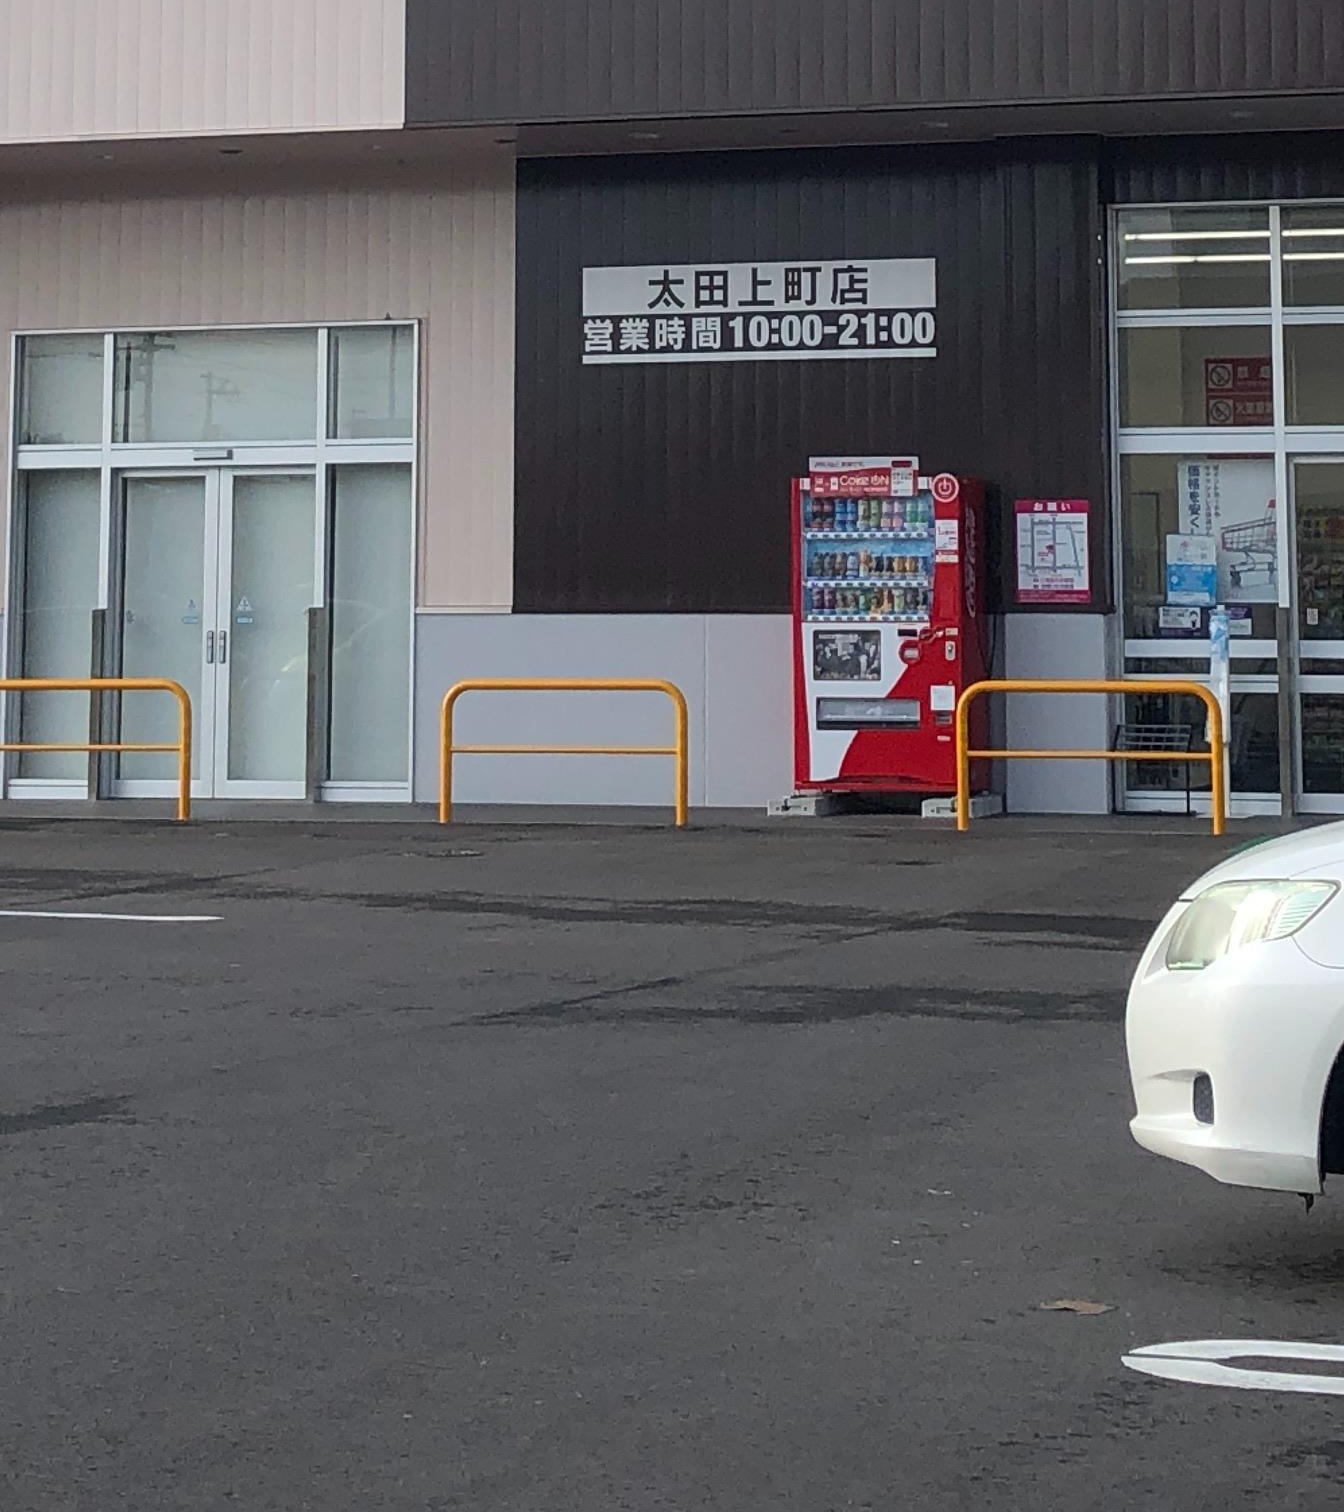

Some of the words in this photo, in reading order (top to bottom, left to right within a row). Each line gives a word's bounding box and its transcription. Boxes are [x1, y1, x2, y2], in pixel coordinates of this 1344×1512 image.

[647, 265, 869, 310] 太田上町店
